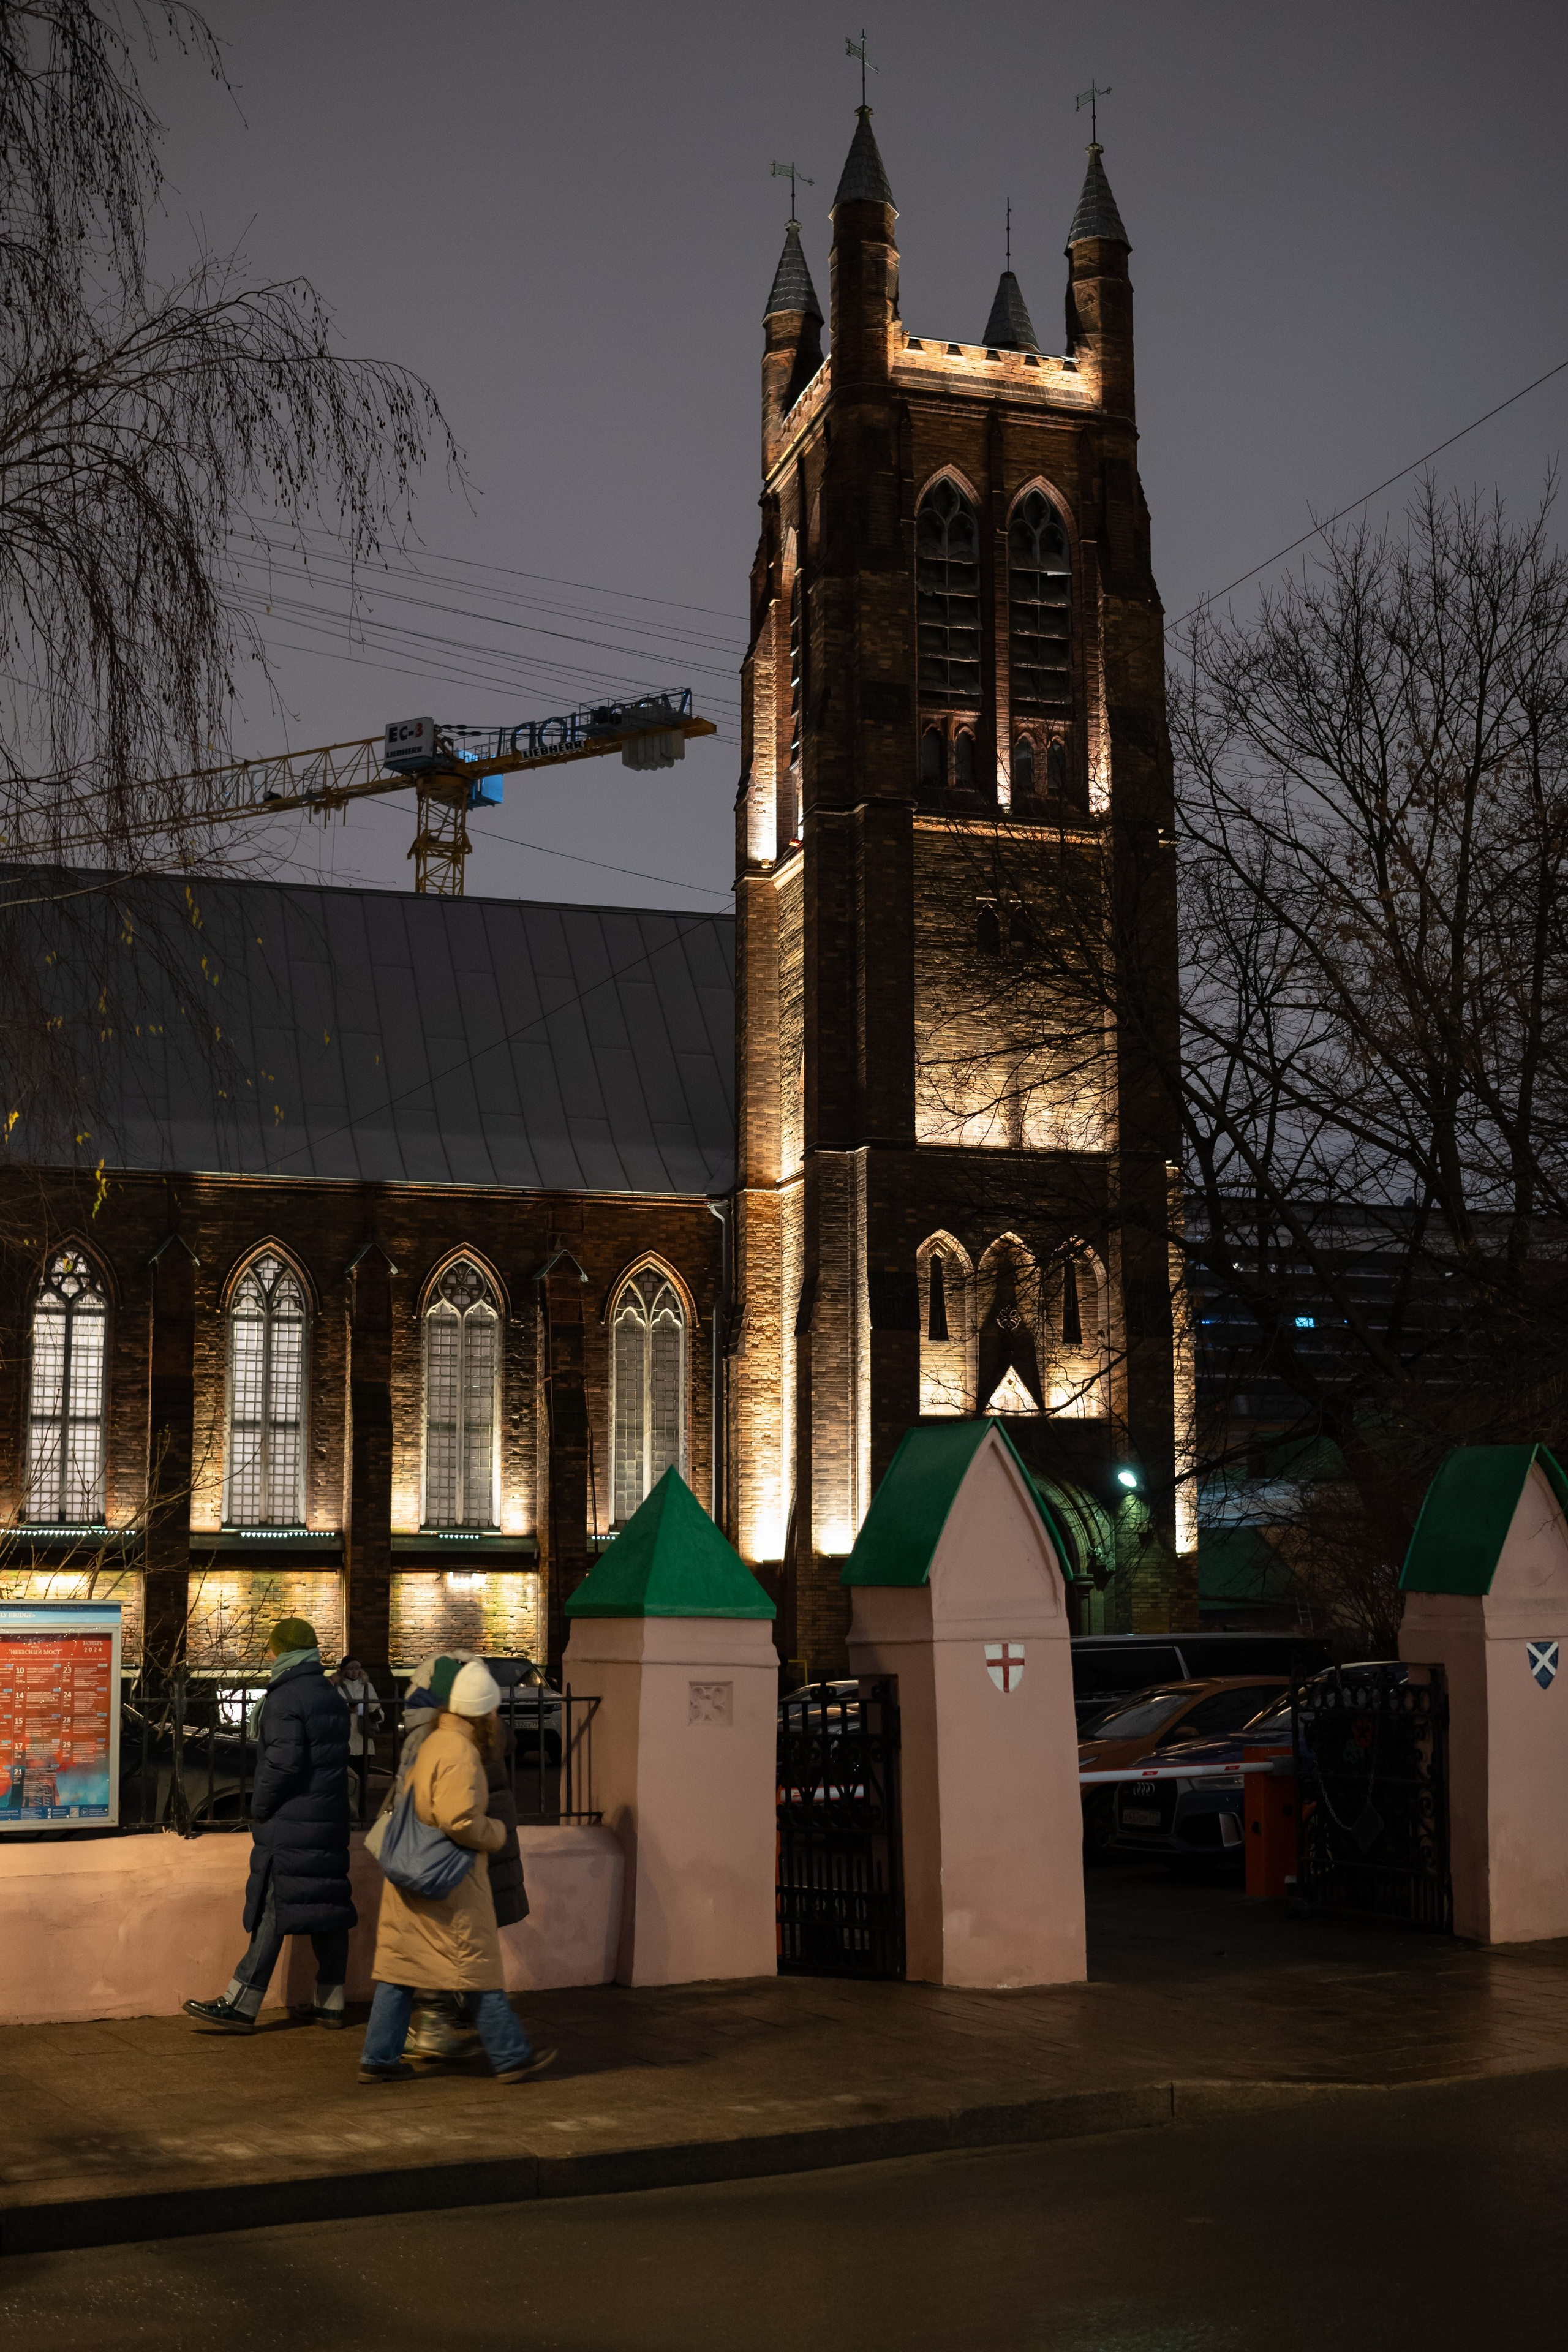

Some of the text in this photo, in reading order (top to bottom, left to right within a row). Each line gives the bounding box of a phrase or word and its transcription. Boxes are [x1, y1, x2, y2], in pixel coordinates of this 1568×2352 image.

[388, 722, 423, 743] EC-3
[386, 746, 423, 758] LIEBHERR
[522, 740, 583, 758] LIEBHERR
